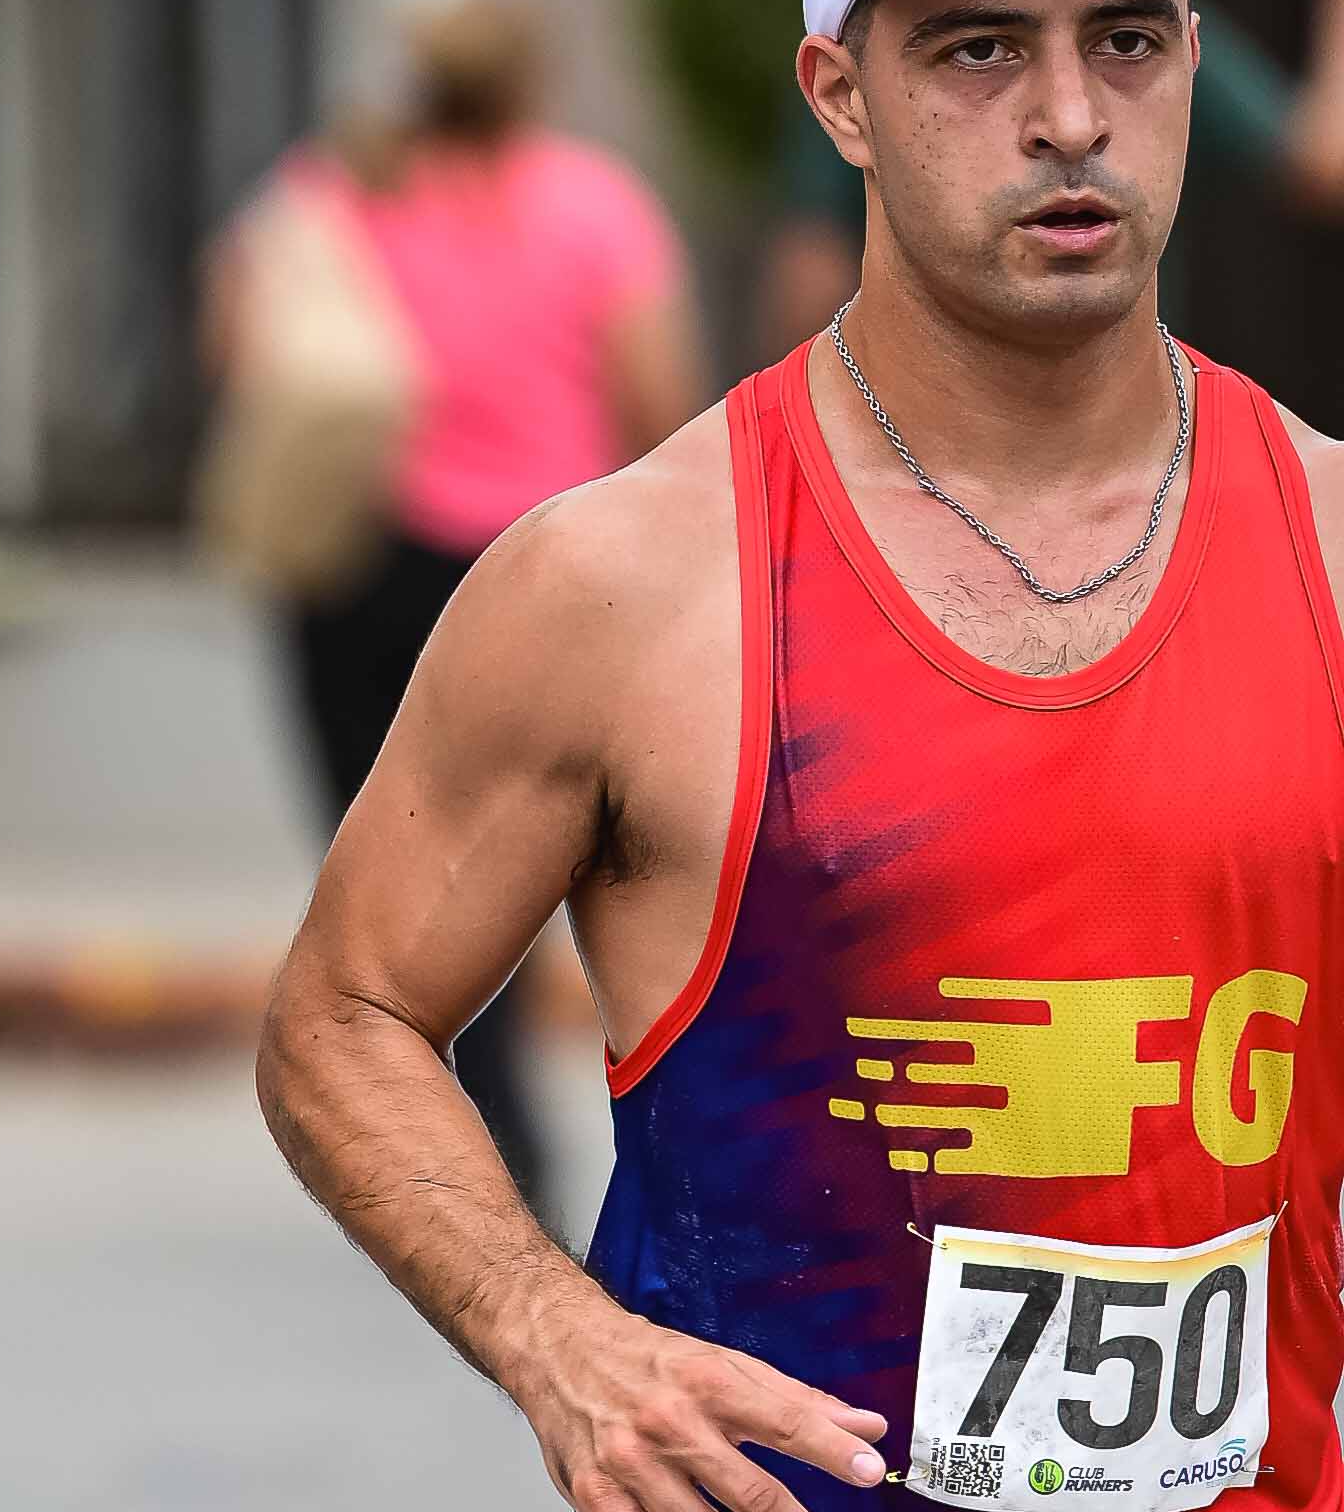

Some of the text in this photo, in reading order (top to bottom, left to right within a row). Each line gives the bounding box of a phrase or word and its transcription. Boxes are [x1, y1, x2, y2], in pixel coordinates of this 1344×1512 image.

[934, 969, 1309, 1179] FG
[957, 1262, 1248, 1450] 750
[1063, 1479, 1135, 1492] RUNNER'S
[1068, 1466, 1105, 1479] CLUB
[1159, 1453, 1244, 1489] CARUSO
